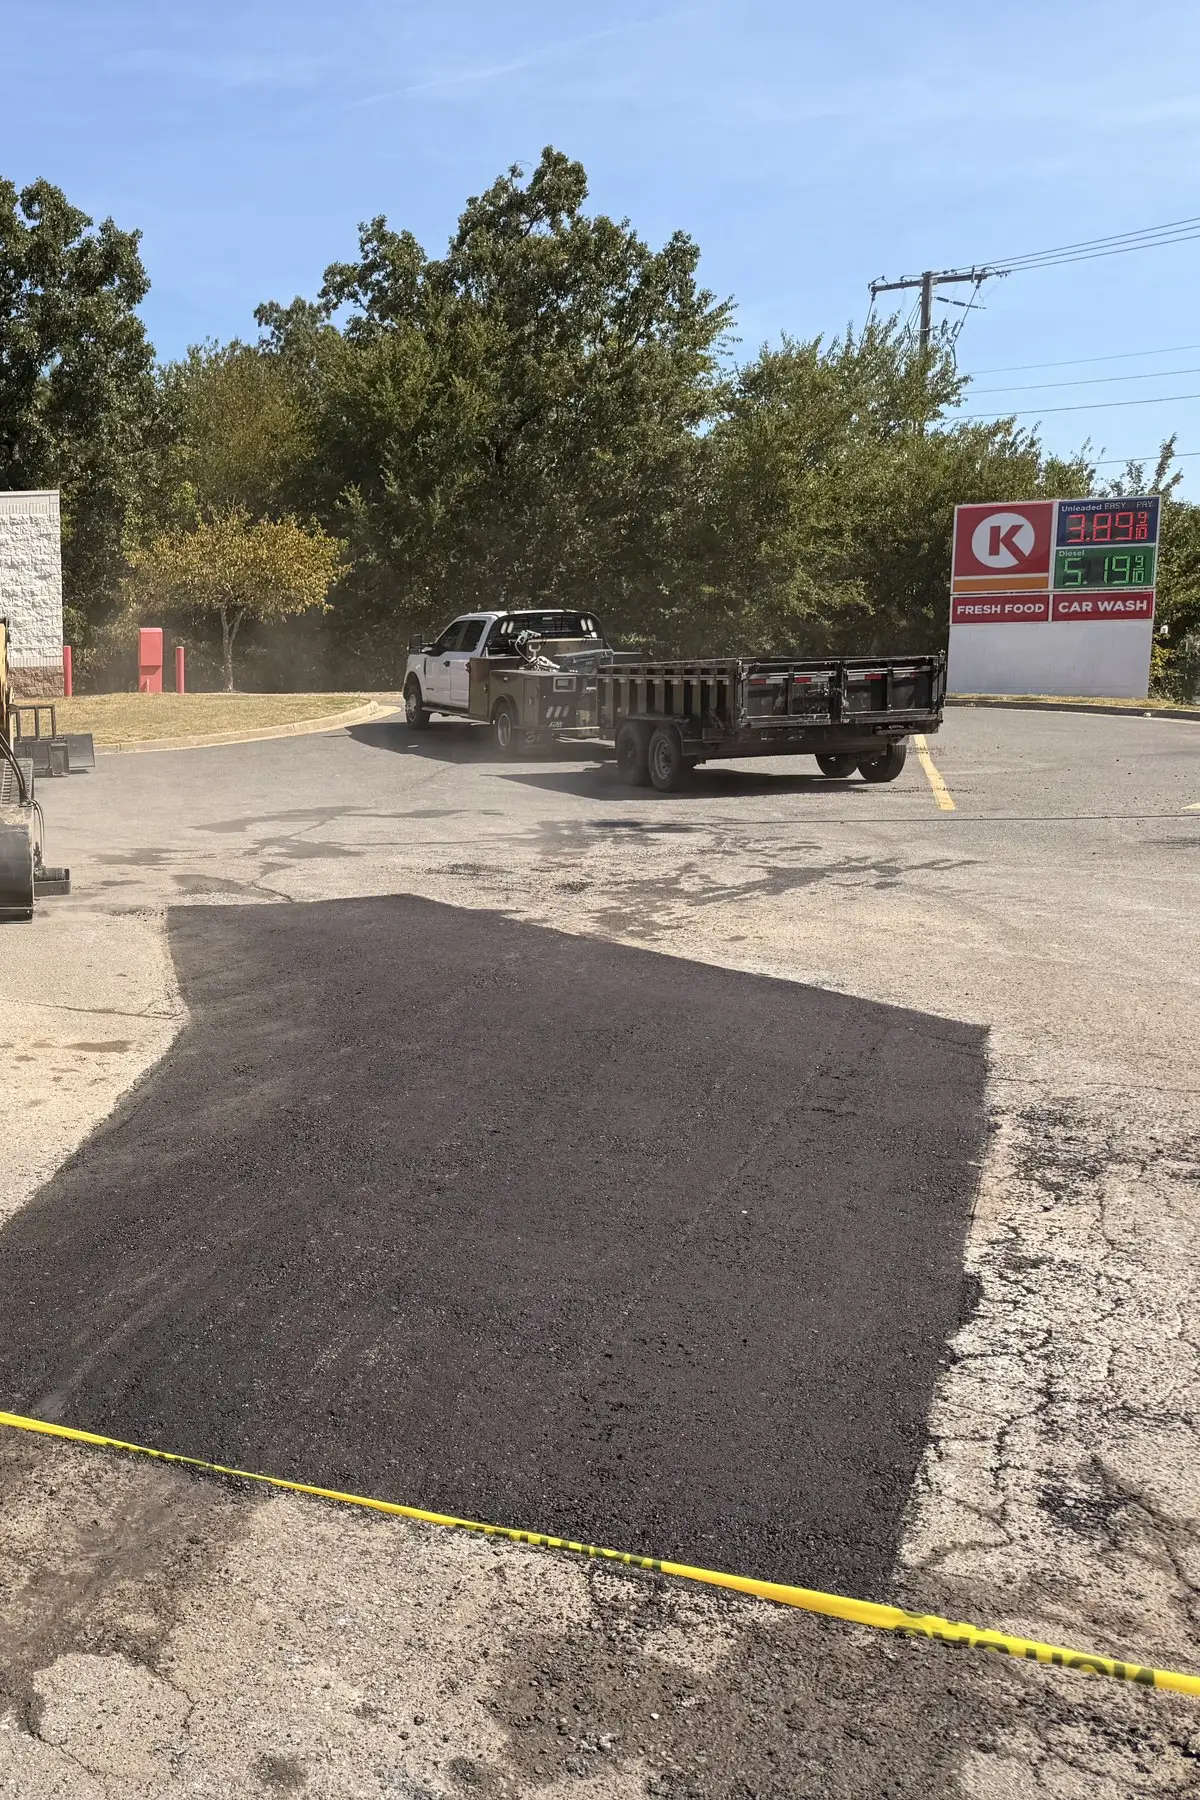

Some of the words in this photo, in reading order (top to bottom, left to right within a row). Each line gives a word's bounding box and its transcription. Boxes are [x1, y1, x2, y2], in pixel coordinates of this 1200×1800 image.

[1061, 504, 1102, 512] Unleaded
[1066, 511, 1134, 543] 3.89
[983, 520, 1031, 565] K
[957, 604, 1001, 615] FRESH
[1004, 603, 1045, 614] FOOD
[1058, 601, 1093, 613] CAR
[1098, 600, 1148, 612] WASH
